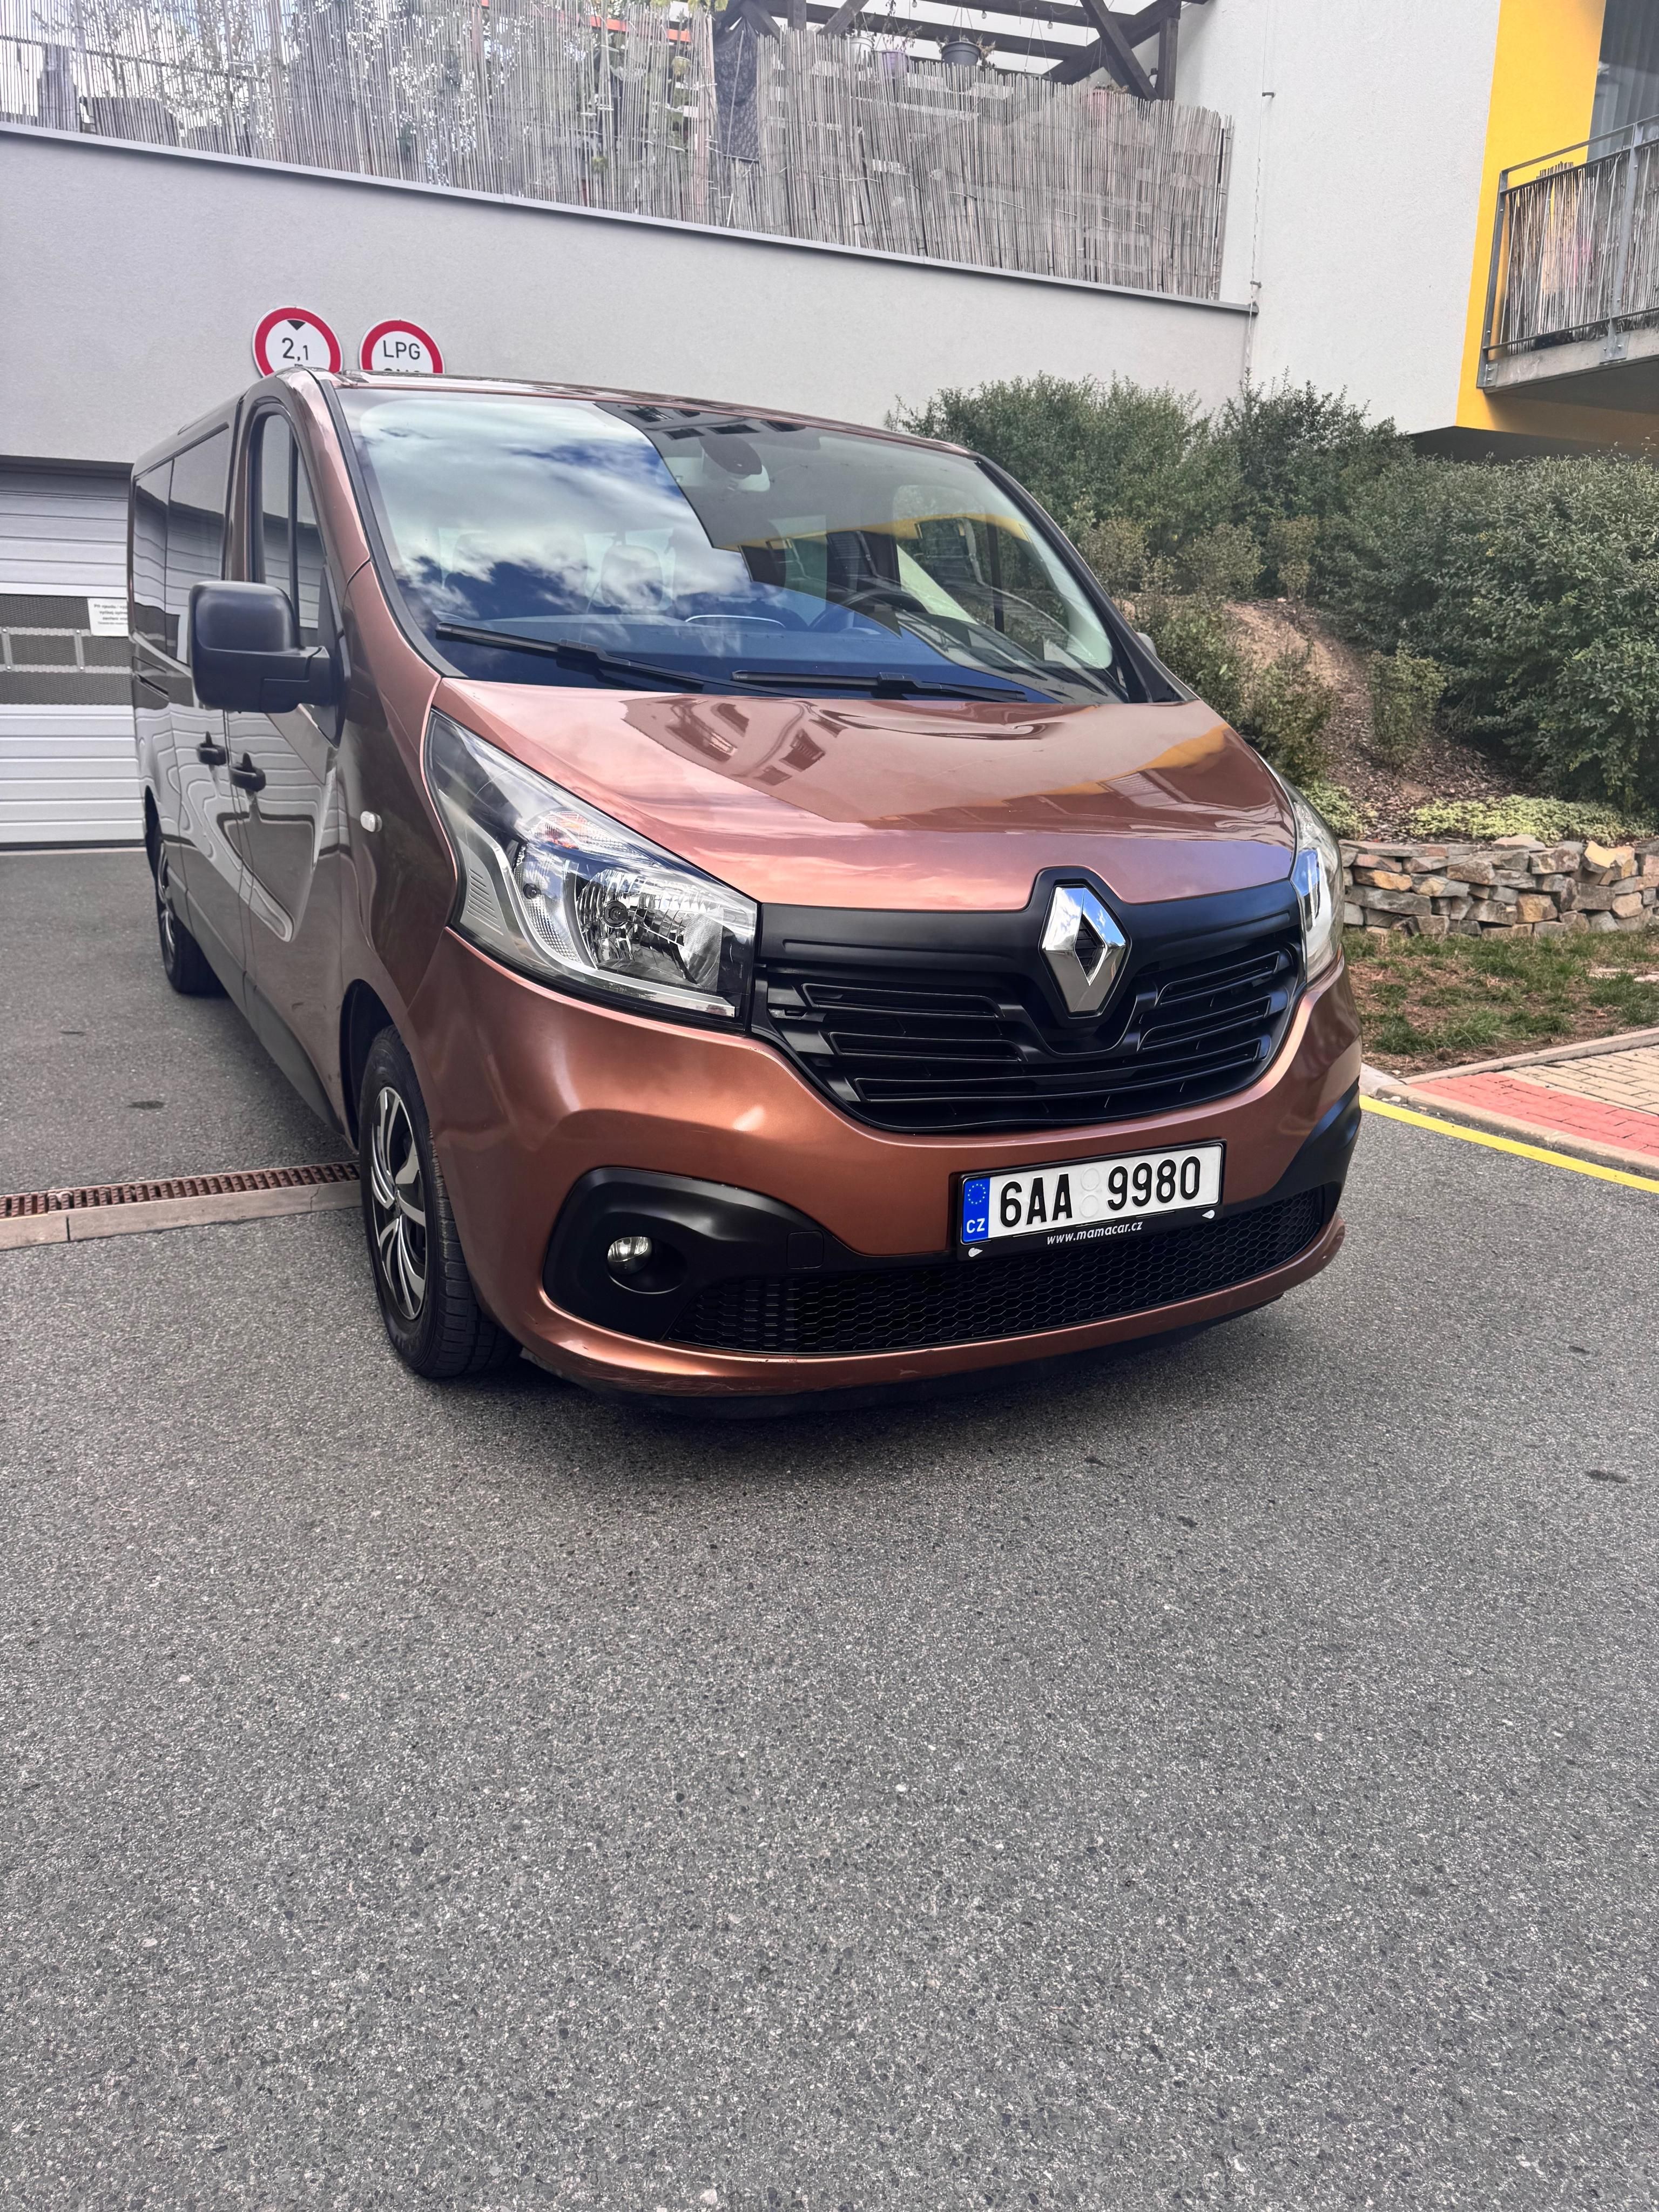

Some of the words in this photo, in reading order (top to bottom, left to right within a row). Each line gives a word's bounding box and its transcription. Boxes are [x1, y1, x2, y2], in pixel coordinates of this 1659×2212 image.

[282, 337, 308, 361] 2,1
[383, 340, 420, 360] LPG
[999, 1173, 1073, 1228] 6AA
[1107, 1155, 1201, 1211] 9980
[966, 1218, 986, 1234] CZ
[1047, 1221, 1143, 1245] www.mamacar.cz
